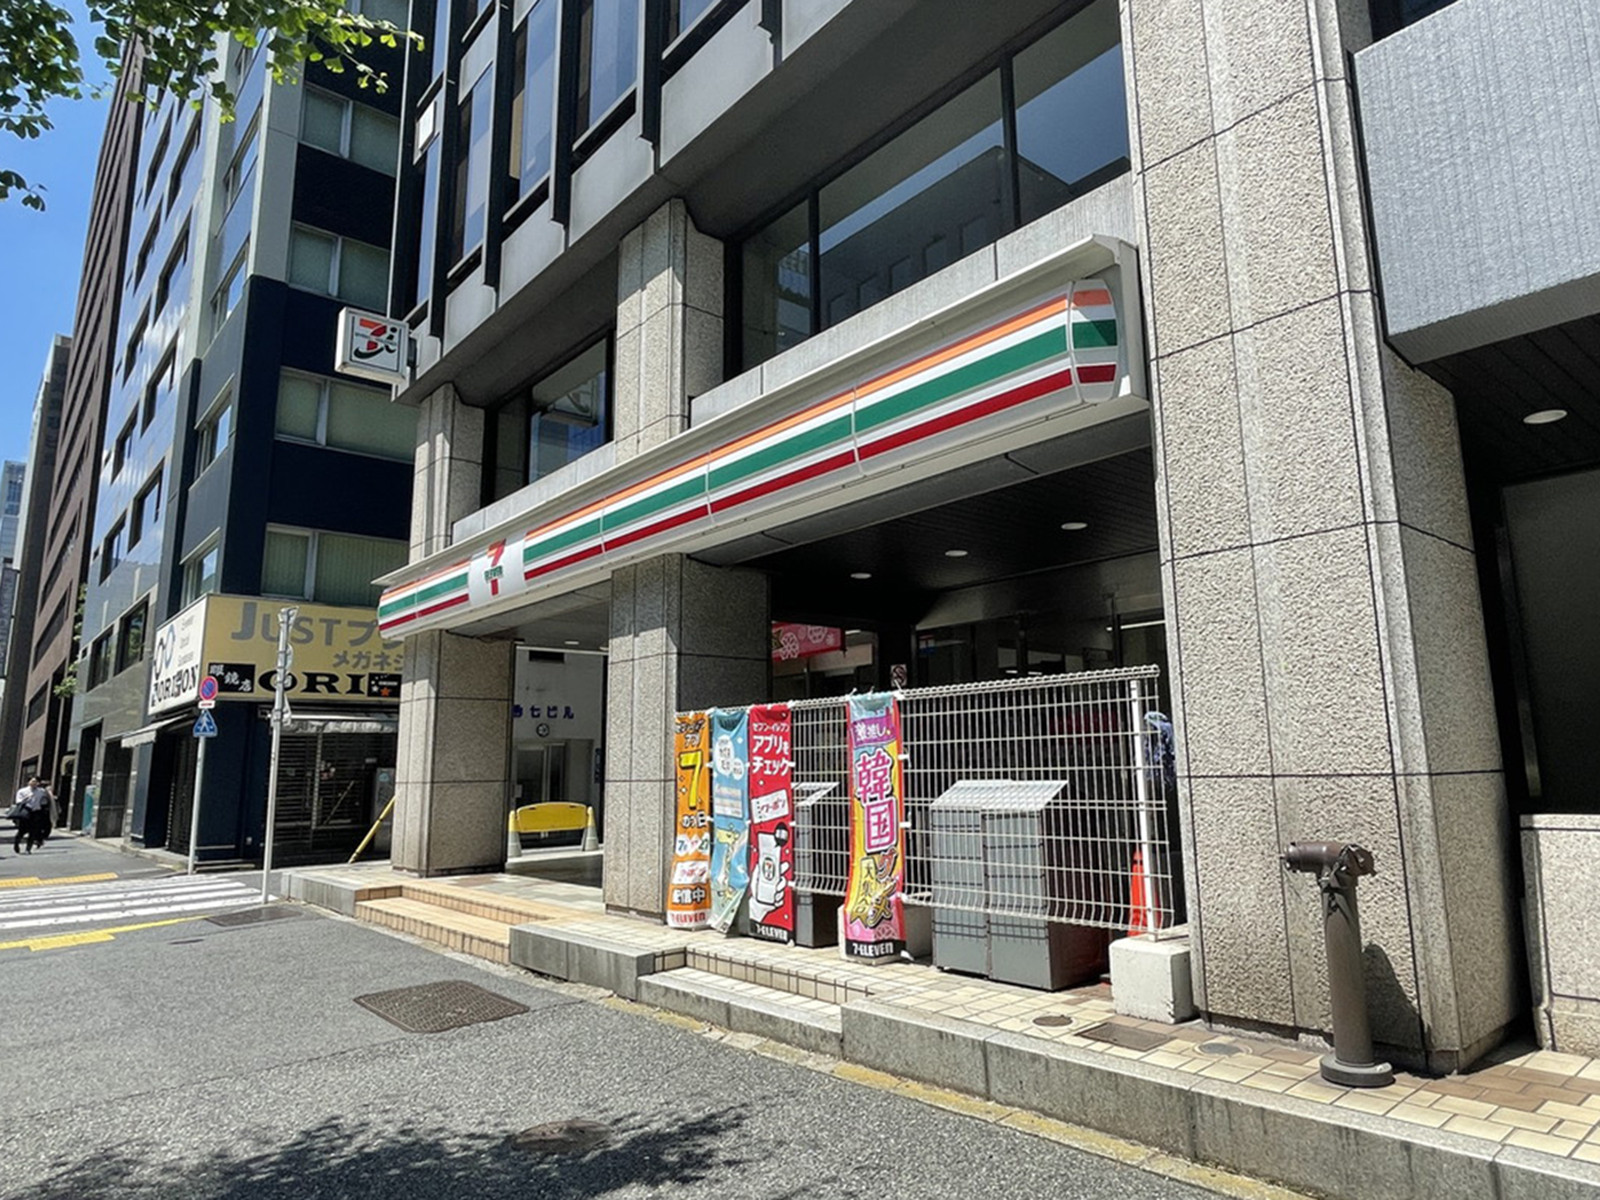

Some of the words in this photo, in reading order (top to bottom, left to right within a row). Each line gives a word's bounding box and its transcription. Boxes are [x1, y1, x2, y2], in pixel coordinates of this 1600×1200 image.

[752, 734, 790, 755] アプリを
[752, 756, 790, 777] チェック
[856, 746, 897, 852] 韓国
